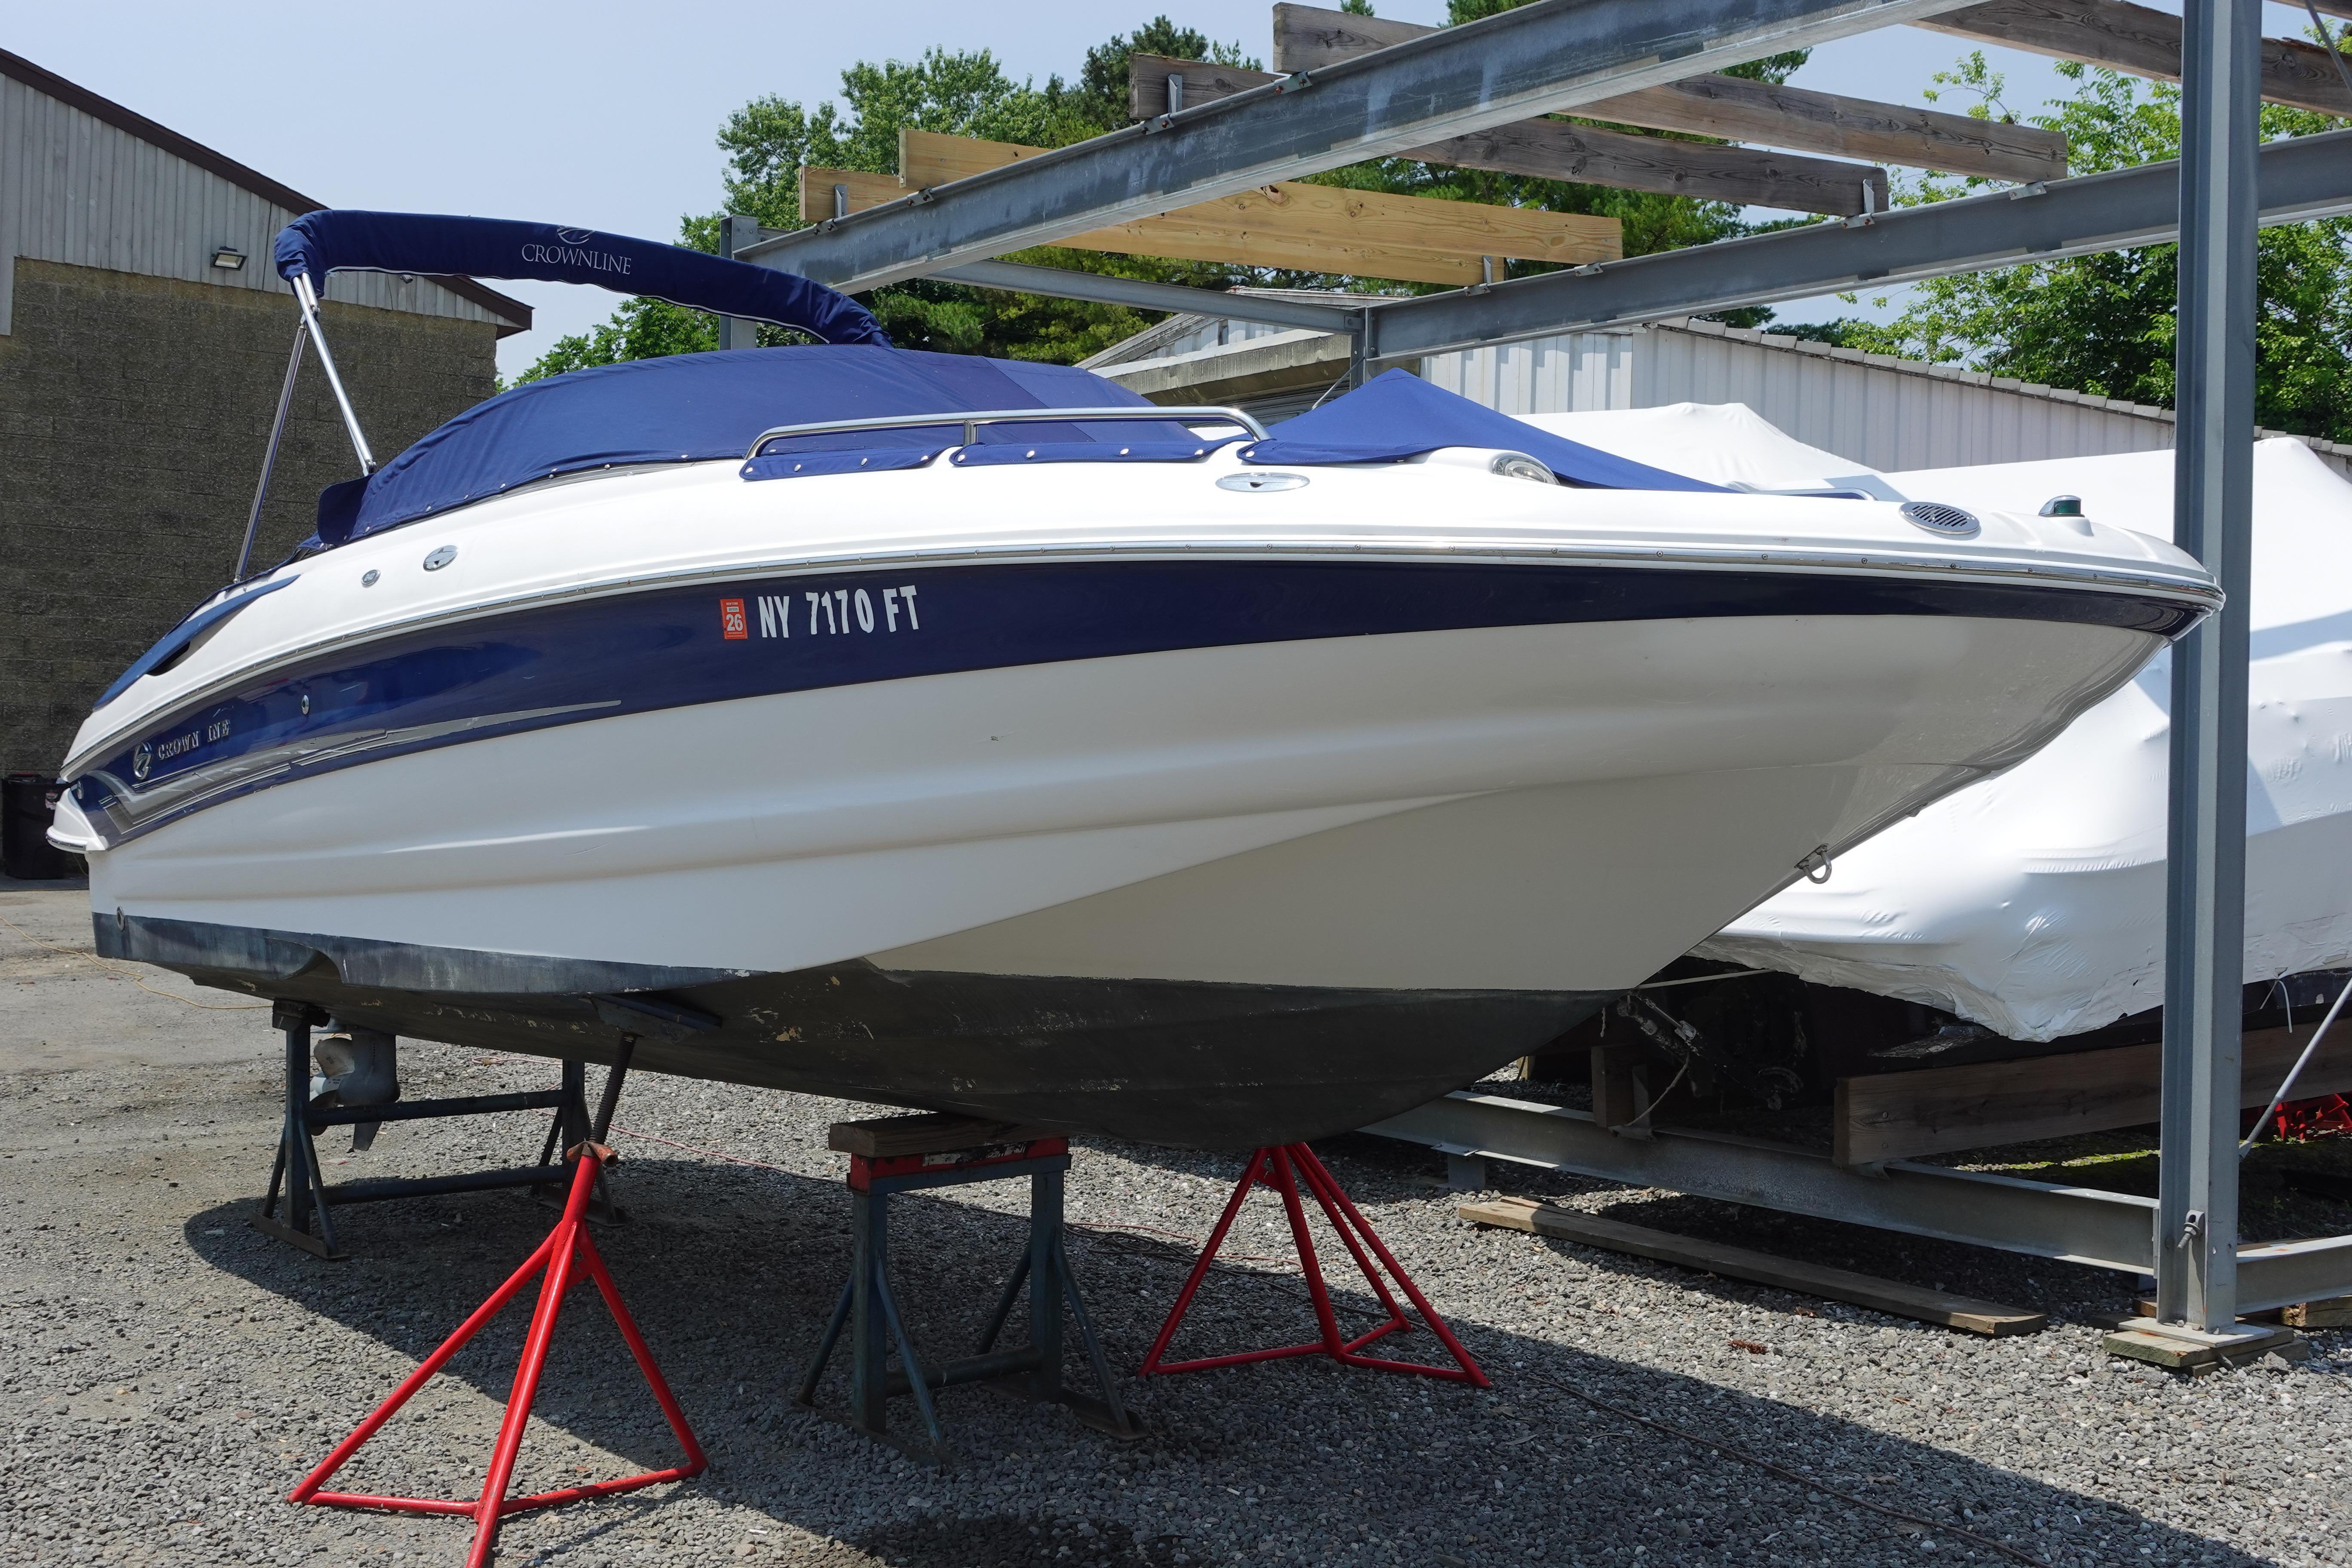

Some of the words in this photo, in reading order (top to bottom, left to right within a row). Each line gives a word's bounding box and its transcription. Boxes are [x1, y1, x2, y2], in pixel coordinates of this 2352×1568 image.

[521, 244, 632, 275] CROWNLINE
[726, 614, 743, 631] 26
[758, 596, 790, 638] NY
[805, 588, 874, 634] 7170
[882, 585, 919, 632] FT
